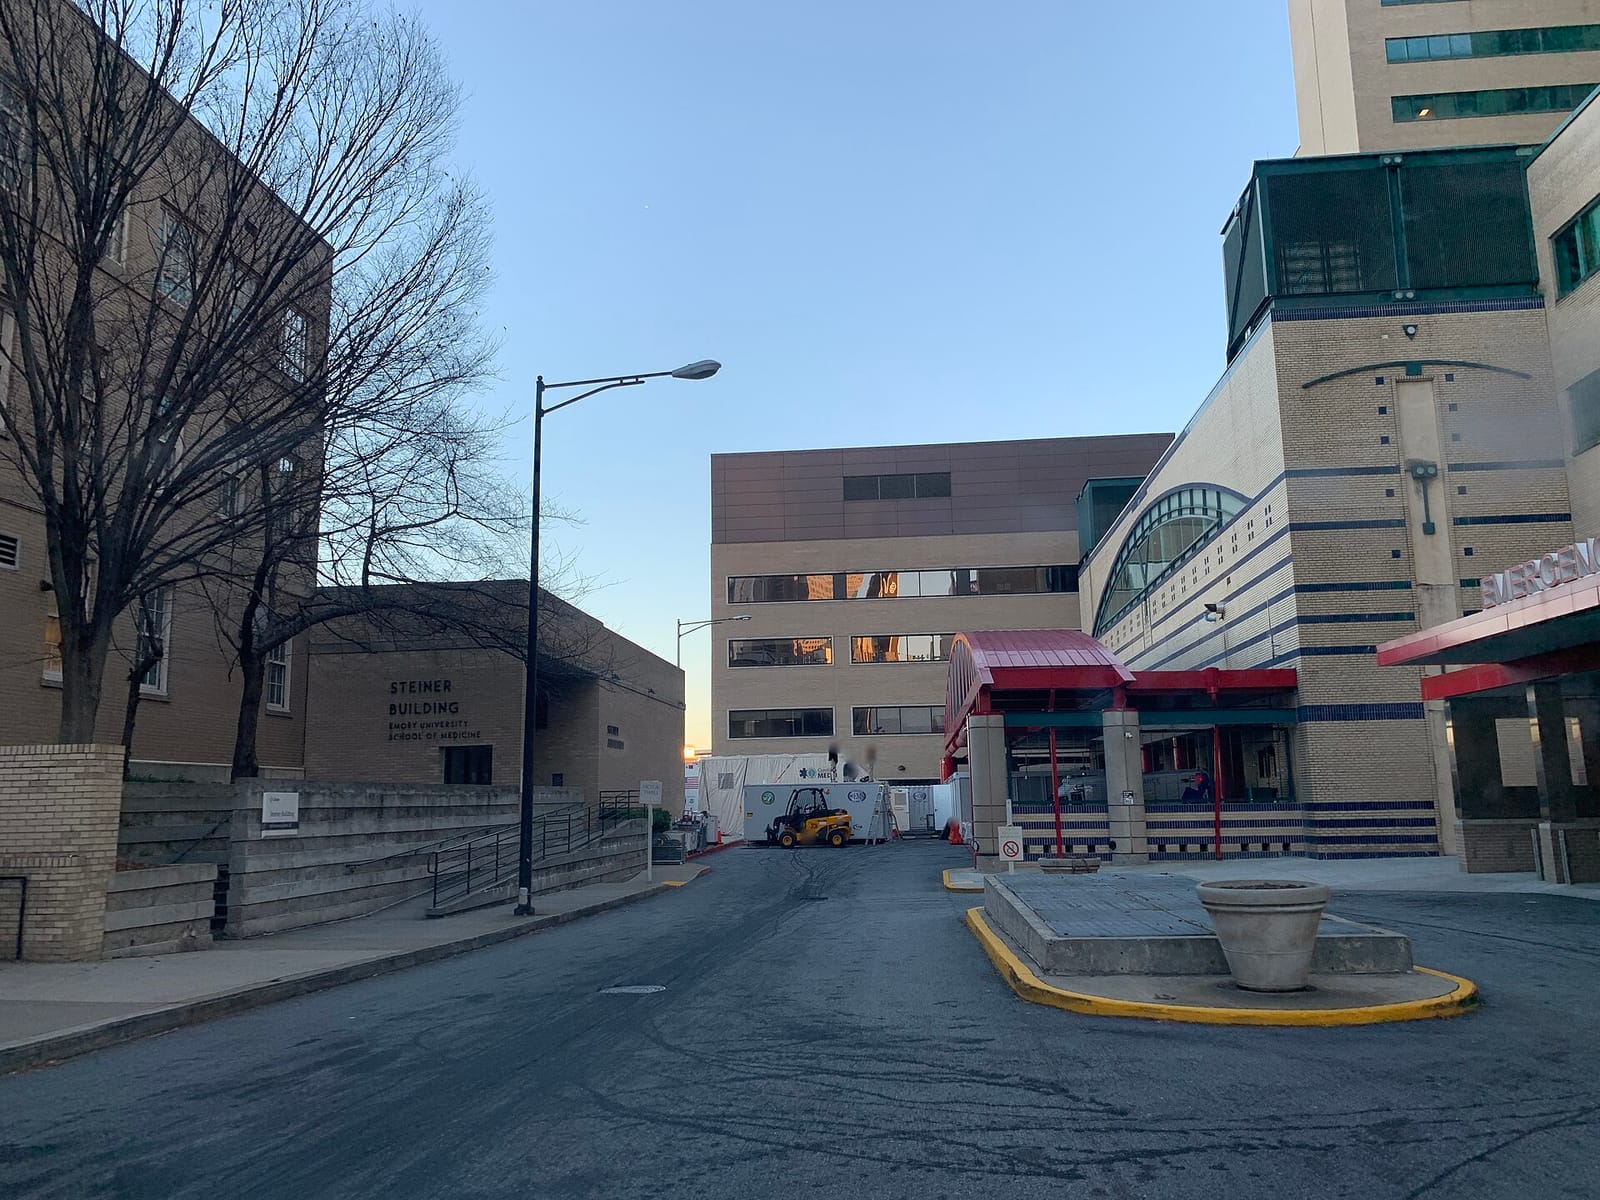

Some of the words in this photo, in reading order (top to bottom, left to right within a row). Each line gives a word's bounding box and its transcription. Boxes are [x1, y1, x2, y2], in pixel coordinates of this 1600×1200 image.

[390, 680, 452, 694] STEINER
[389, 702, 459, 716] BUILDING
[389, 721, 417, 730] EMORY
[420, 720, 468, 729] UNIVERSITY
[388, 732, 422, 741] SCHOOL
[426, 732, 437, 740] OF
[440, 731, 481, 739] MEDICINE
